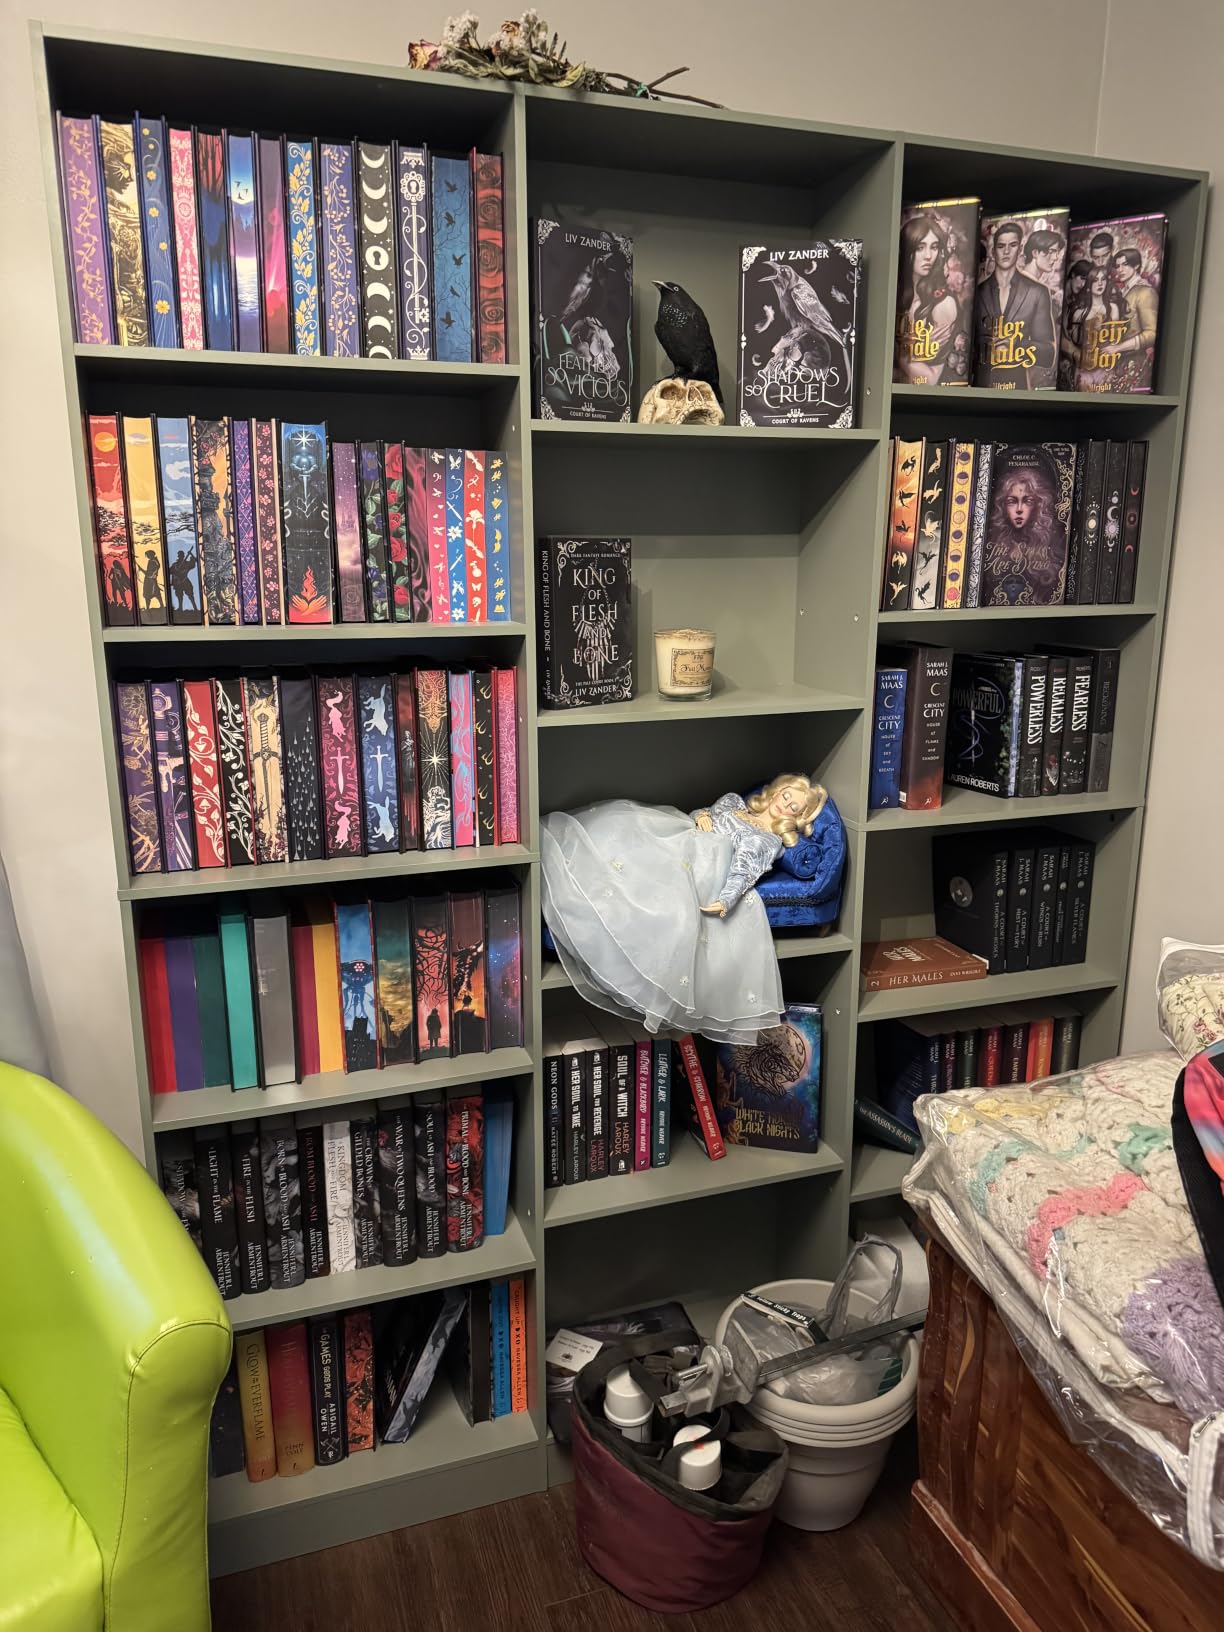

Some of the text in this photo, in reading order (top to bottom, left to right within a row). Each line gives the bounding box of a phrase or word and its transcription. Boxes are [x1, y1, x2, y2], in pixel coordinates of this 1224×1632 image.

[565, 233, 612, 251] LIV ZANDER
[770, 249, 829, 262] LIV ZANDER
[545, 366, 627, 406] SO VICIOUS
[758, 366, 839, 387] SHADOWS
[745, 381, 848, 408] SO CRUEL
[542, 572, 549, 584] OF
[573, 567, 616, 588] KING
[542, 585, 550, 608] FLESH
[588, 590, 602, 600] OF
[572, 601, 618, 622] FLESH
[583, 627, 607, 639] AND
[573, 645, 618, 667] BONE
[576, 685, 618, 697] LIV ZANDER
[880, 681, 904, 690] MAAS
[923, 708, 945, 718] CITY
[952, 688, 1001, 714] POWERFUL
[1027, 676, 1046, 744] POWERLESS
[1050, 677, 1067, 734] RECKLESS
[1071, 675, 1091, 731] FEARLESS
[878, 720, 901, 730] CITY
[970, 778, 1000, 792] ROBERTS
[889, 975, 908, 986] HER
[912, 972, 944, 984] MALES
[617, 1056, 628, 1078] SOUL
[658, 1054, 668, 1077] LEATHER
[684, 1044, 698, 1070] SCYTHE
[550, 1061, 558, 1085] NEON
[572, 1070, 581, 1085] HER
[550, 1086, 558, 1110] GODS
[572, 1086, 581, 1105] SOUL
[593, 1066, 602, 1136] HER SOUL REVENGE
[617, 1092, 628, 1118] WITCH
[658, 1086, 667, 1103] LARK
[572, 1112, 581, 1128] TAKE
[736, 1108, 765, 1123] WHITE
[866, 1110, 897, 1134] ASSASSIN'S
[614, 1122, 622, 1155] LAROUX
[622, 1122, 630, 1154] HARLEY
[734, 1120, 800, 1140] BLACK NIGHTS
[354, 1132, 364, 1198] GILDED BONES
[364, 1147, 374, 1182] CROWN
[426, 1113, 436, 1194] SOUL ASH BLOOD
[461, 1110, 470, 1196] PRIMAL BLOOD BONE
[590, 1139, 598, 1173] LAROUX
[598, 1139, 606, 1171] HARLEY
[328, 1140, 338, 1201] FLESH FIRE
[337, 1146, 346, 1191] KINGDOM
[394, 1124, 406, 1212] WAR TWO QUEENS
[208, 1150, 222, 1224] LIGHT FLAME
[242, 1158, 256, 1223] FIRE FLESH
[276, 1140, 290, 1231] BORN BLOOD ASH
[394, 1214, 402, 1260] ARMENTROUT
[426, 1206, 434, 1252] ARMENTROUT
[459, 1200, 468, 1248] ARMENTROUT
[309, 1228, 318, 1274] ARMENTROUT
[360, 1218, 368, 1262] ARMENTROUT
[247, 1242, 257, 1290] ARMENTROUT
[280, 1234, 290, 1282] ARMENTROUT
[215, 1248, 226, 1296] ARMENTROUT
[246, 1343, 260, 1380] GLOW
[320, 1333, 332, 1398] GAMES GODS PLAY
[251, 1384, 266, 1441] EVERFLAME
[320, 1408, 328, 1433] OWEN
[328, 1402, 337, 1434] ABIGAIL
